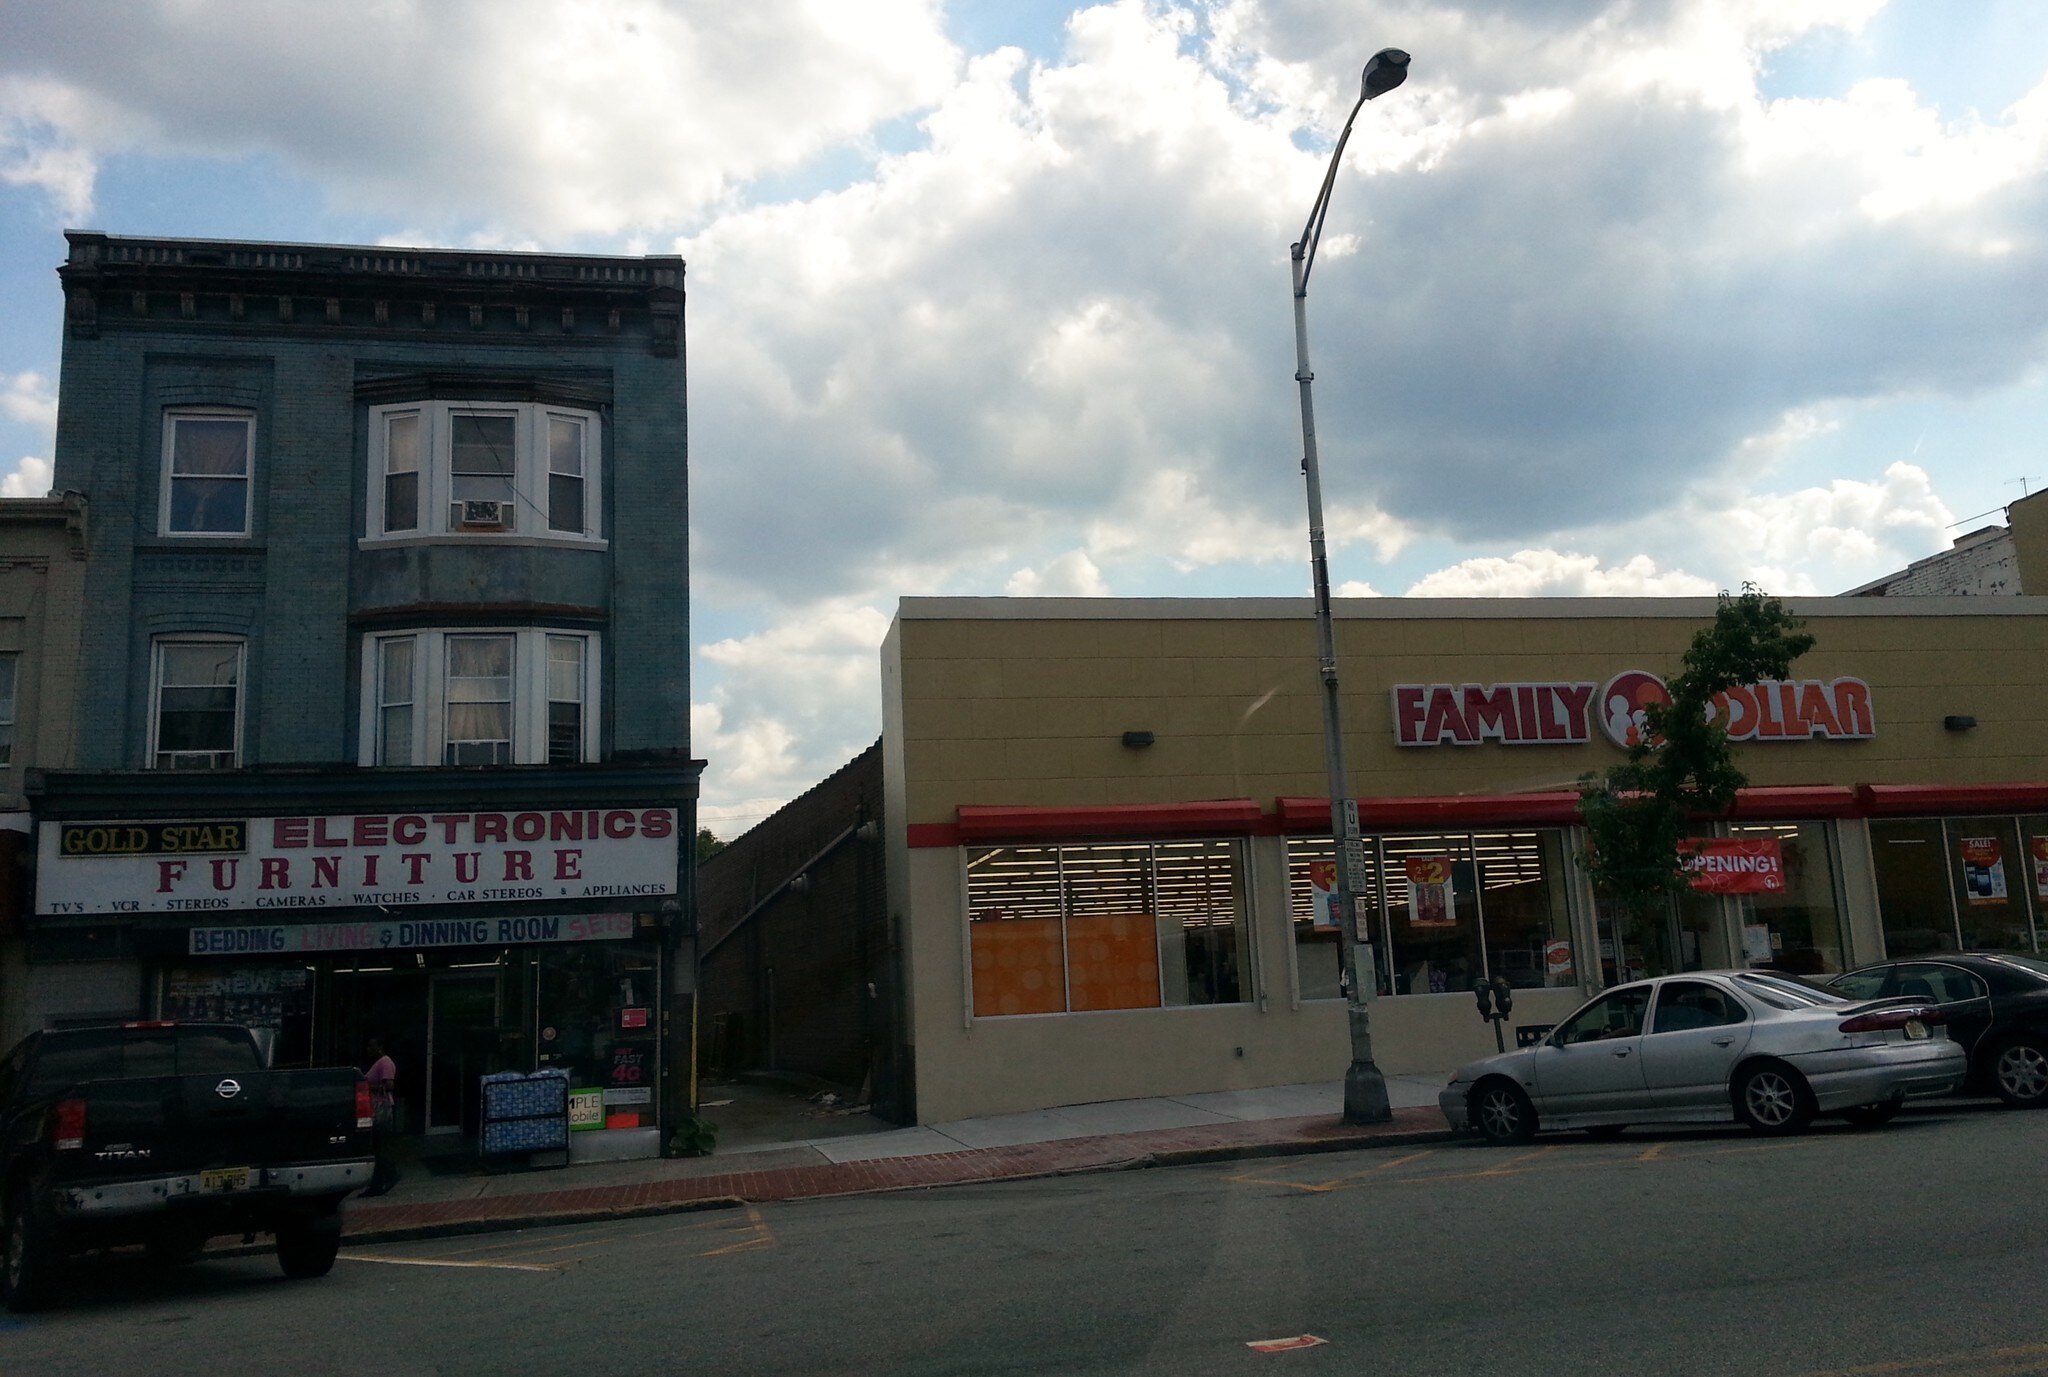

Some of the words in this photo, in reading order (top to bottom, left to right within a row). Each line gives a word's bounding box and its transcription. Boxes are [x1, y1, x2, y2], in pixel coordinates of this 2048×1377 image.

[1395, 686, 1594, 742] FAMILY
[274, 809, 672, 848] ELECTRONICS
[1348, 813, 1356, 824] U
[64, 828, 148, 853] GOLD
[161, 825, 240, 850] STAR
[156, 849, 582, 893] FURNITURE
[51, 902, 84, 914] TV'S
[112, 900, 140, 912] VCR
[166, 898, 229, 911] STEREOS
[256, 895, 326, 908] CAMERAS
[353, 892, 420, 904] WATCHES
[447, 890, 476, 901] CAR
[483, 887, 542, 900] STEREOS
[582, 883, 666, 896] APPLIANCES
[193, 928, 285, 952] BEDDING
[303, 925, 375, 950] LIVING
[400, 920, 488, 946] DINNING
[498, 917, 559, 942] ROOM
[569, 913, 632, 939] SETS
[611, 1064, 641, 1081] 4G
[613, 1054, 643, 1064] FAST
[94, 1149, 152, 1160] TITAN
